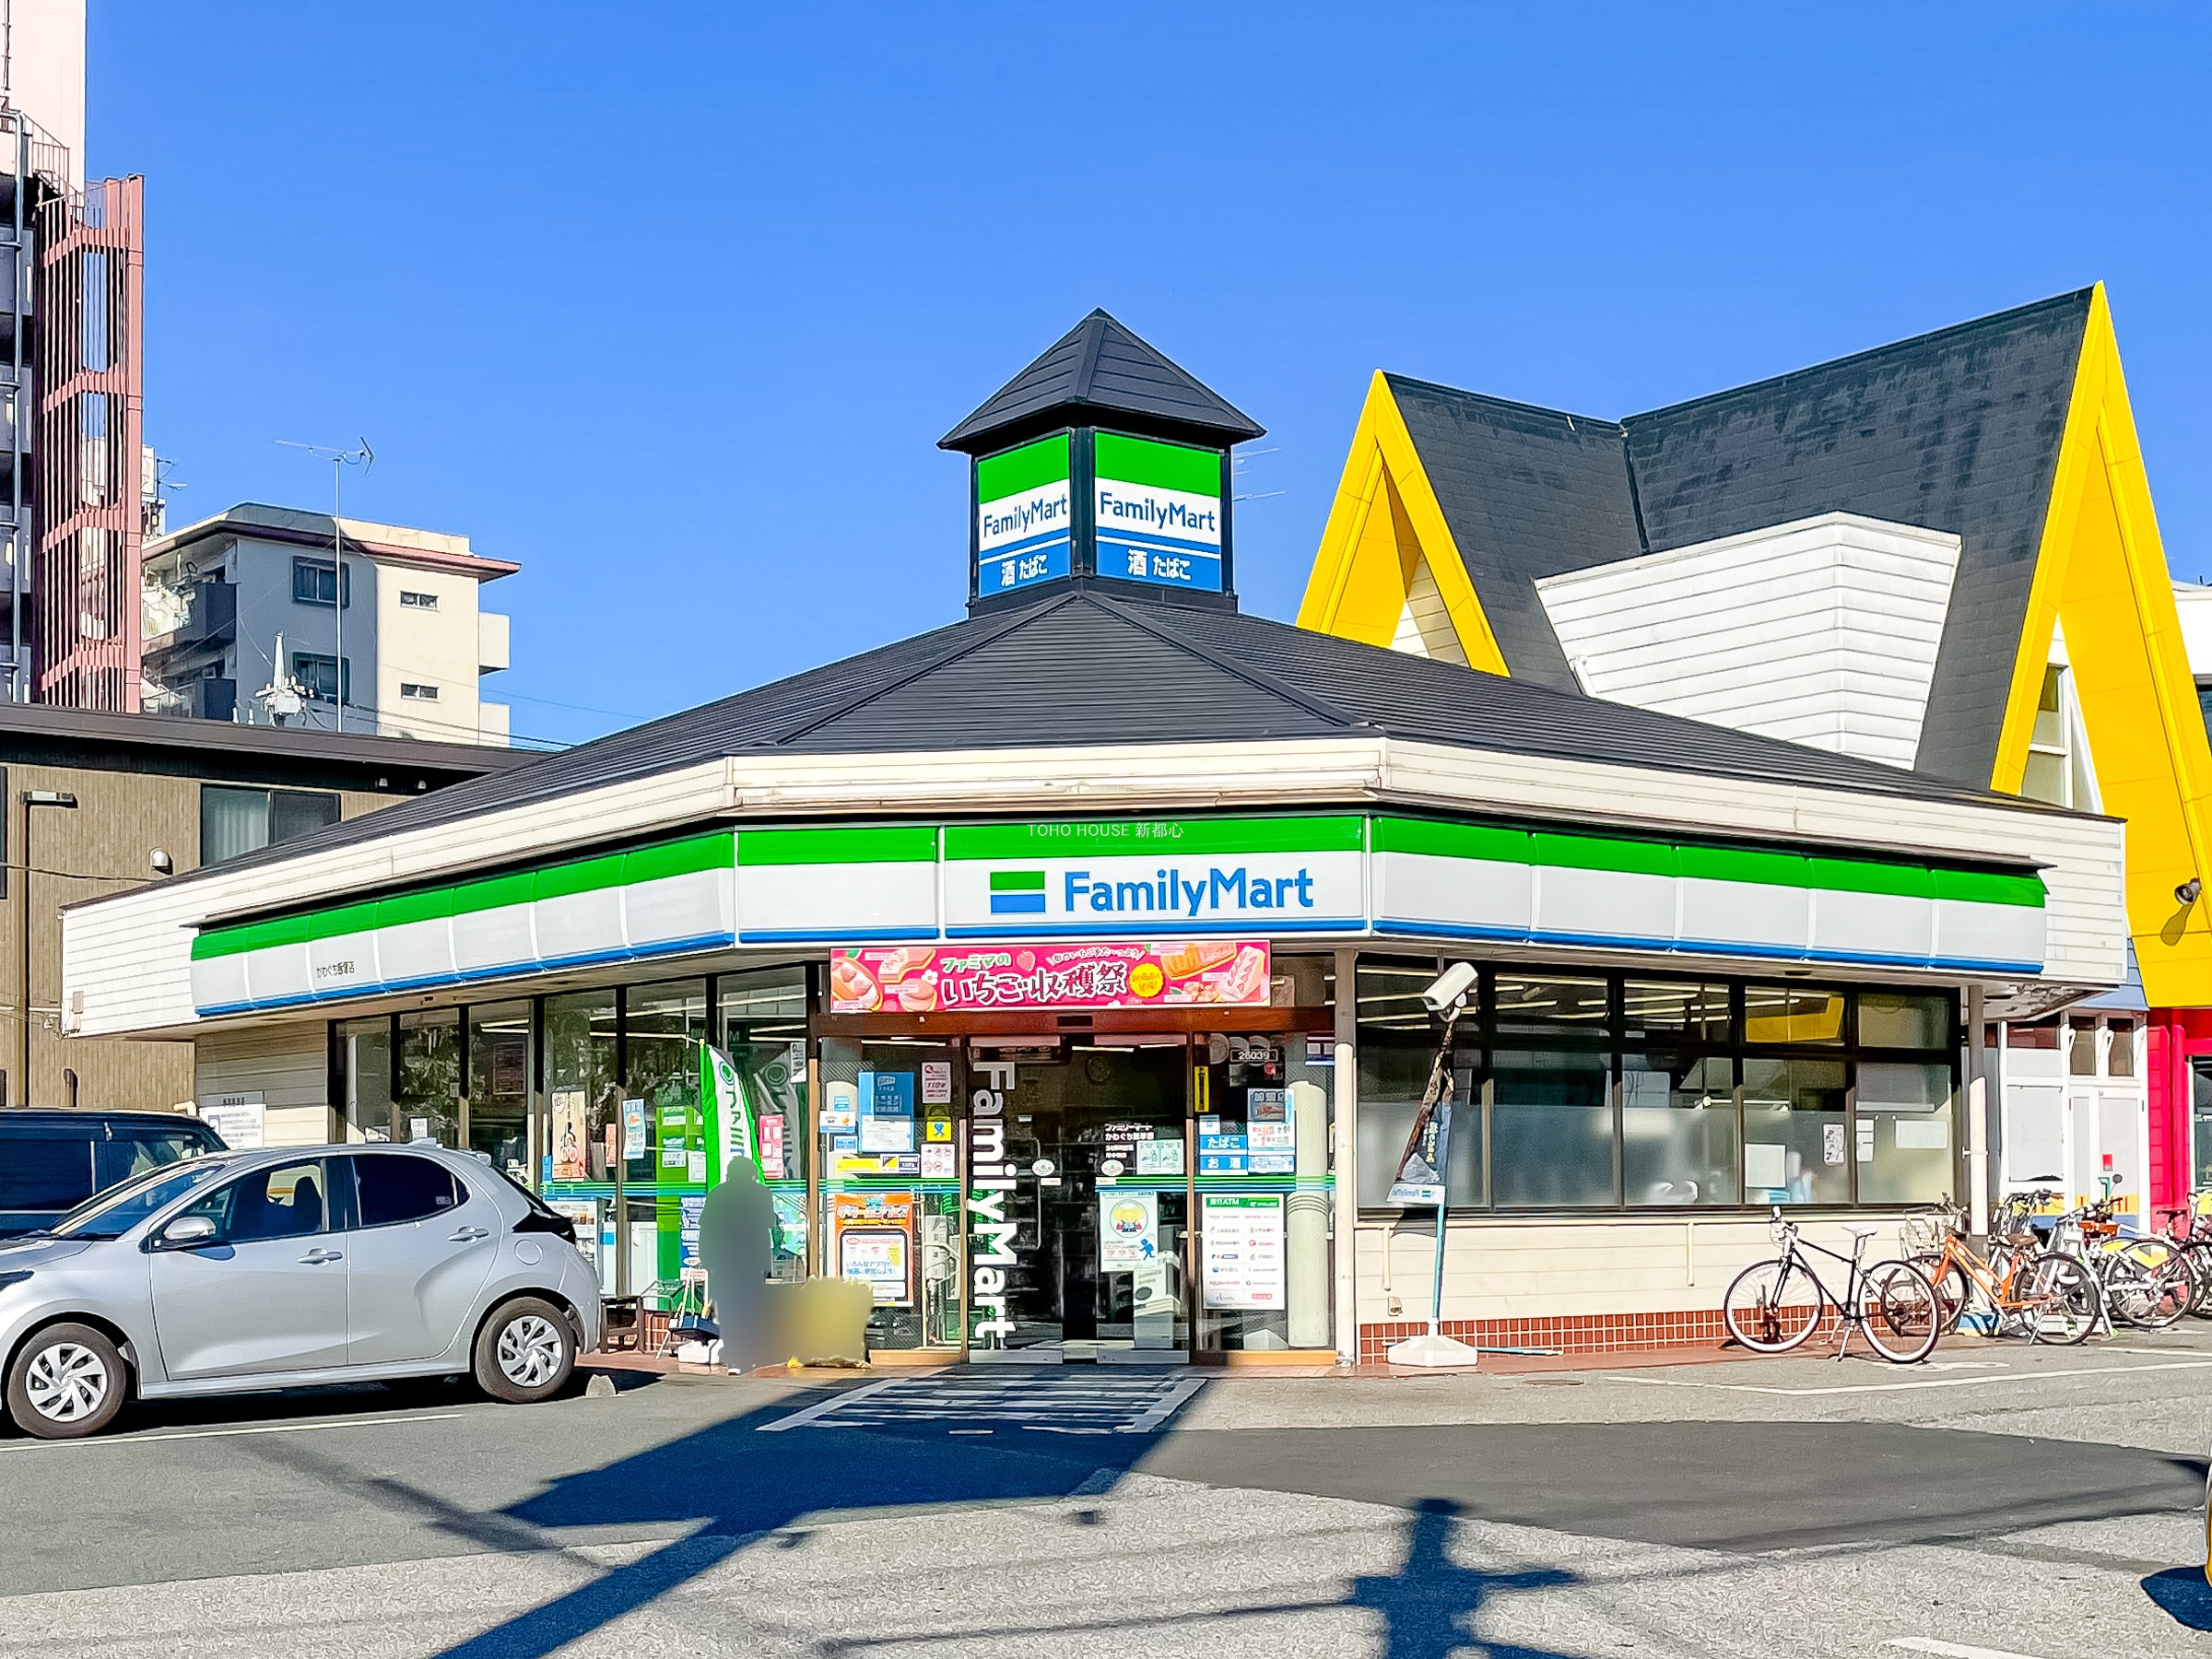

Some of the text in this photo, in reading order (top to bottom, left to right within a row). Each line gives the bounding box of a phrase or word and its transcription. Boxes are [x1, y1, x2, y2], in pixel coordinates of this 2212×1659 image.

[983, 493, 1067, 538] FamilyMart
[1100, 491, 1216, 532] FamilyMart
[1001, 554, 1049, 586] 酒 たばこ
[1127, 549, 1192, 581] 酒 たばこ
[1065, 866, 1314, 917] FamilyMart
[941, 952, 1011, 973] ファミマの
[943, 963, 1127, 1006] いちご収穫祭
[1238, 1051, 1270, 1060] 26039
[1207, 1137, 1240, 1148] たばこ
[1207, 1157, 1218, 1169] お
[968, 1061, 1018, 1339] FamilyMart
